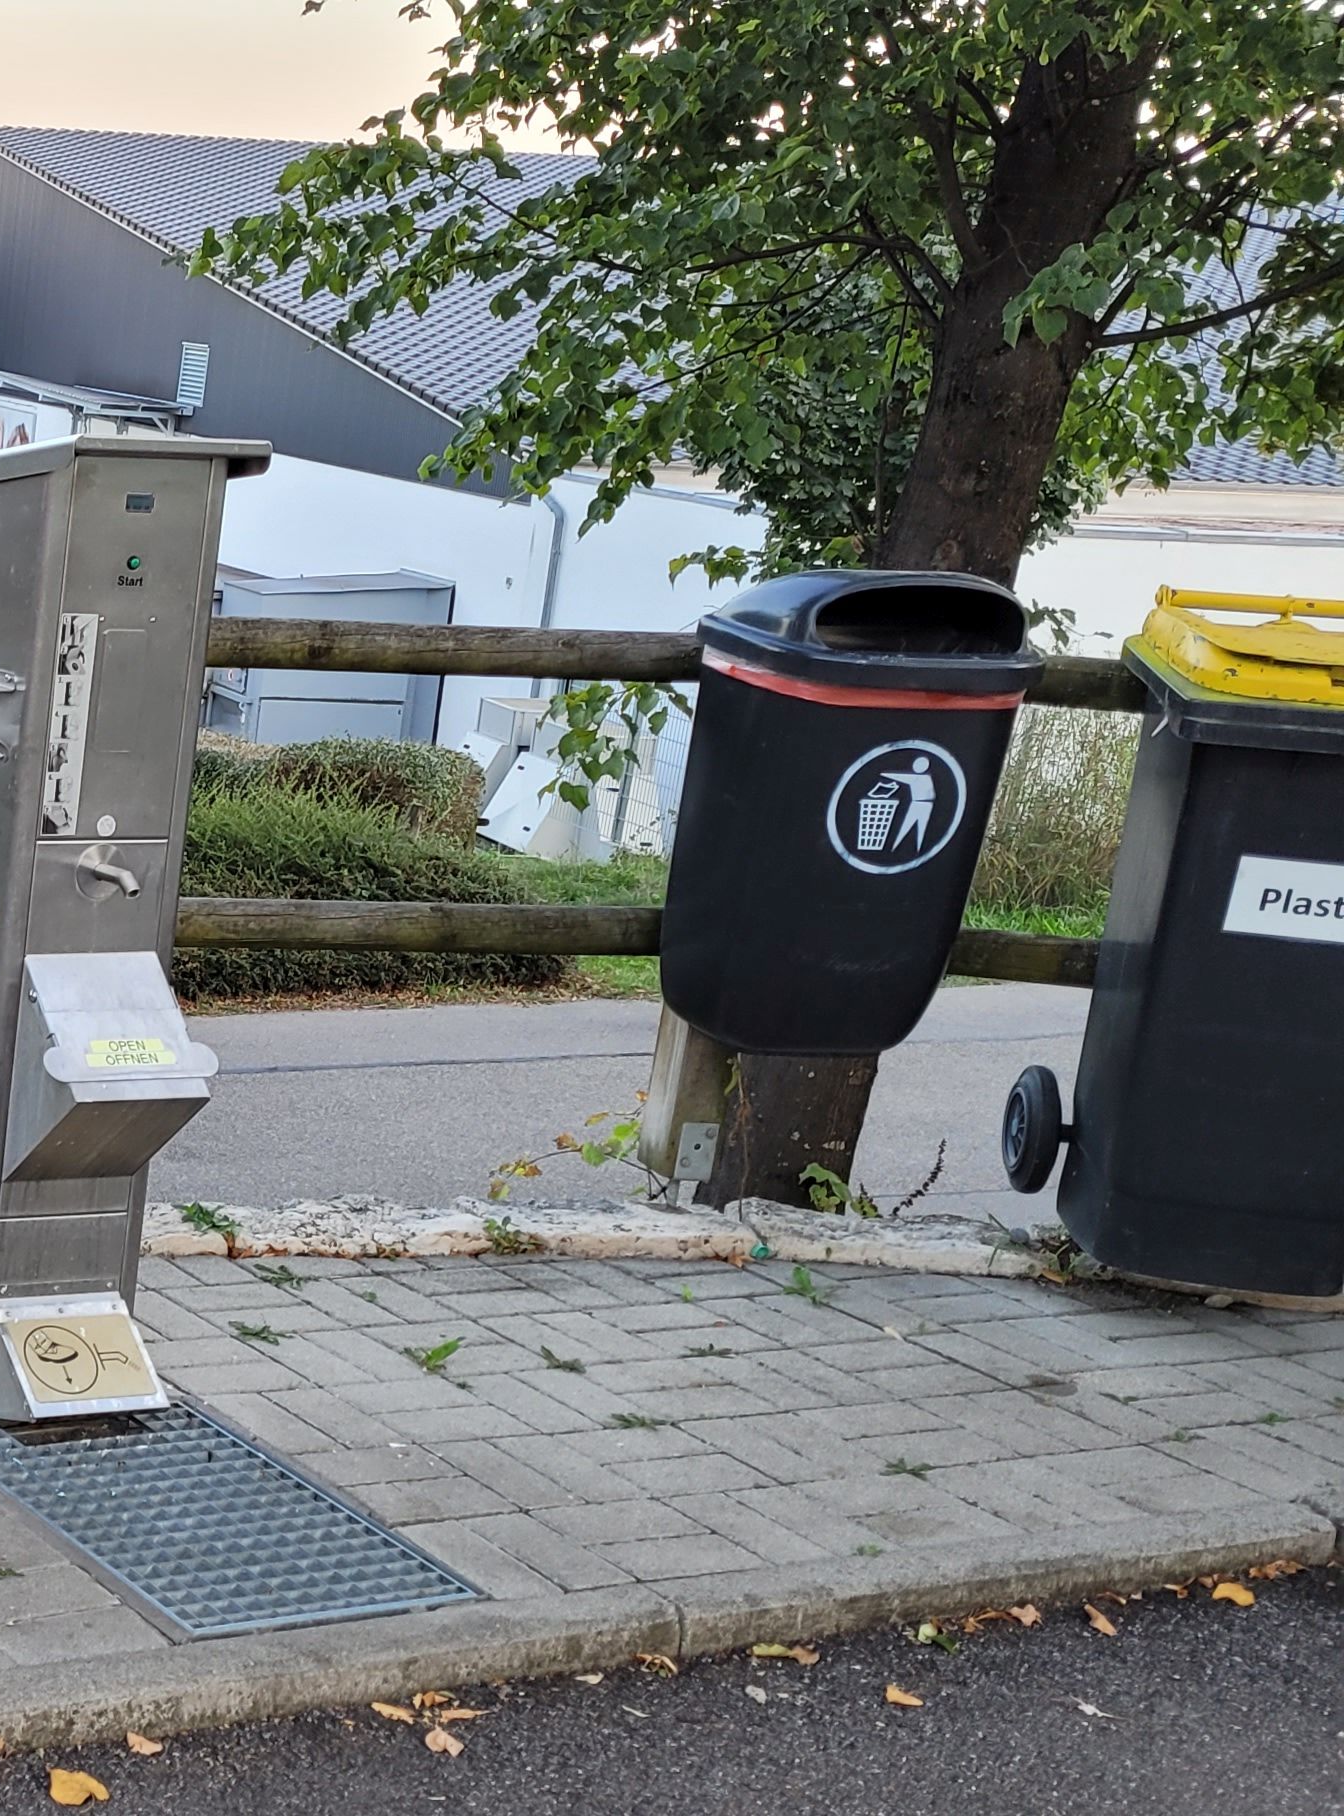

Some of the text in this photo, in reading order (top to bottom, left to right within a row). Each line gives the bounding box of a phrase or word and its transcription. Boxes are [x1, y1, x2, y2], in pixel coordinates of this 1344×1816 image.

[117, 575, 144, 587] Start
[1258, 887, 1344, 919] Plast
[108, 1040, 146, 1051] OPEN
